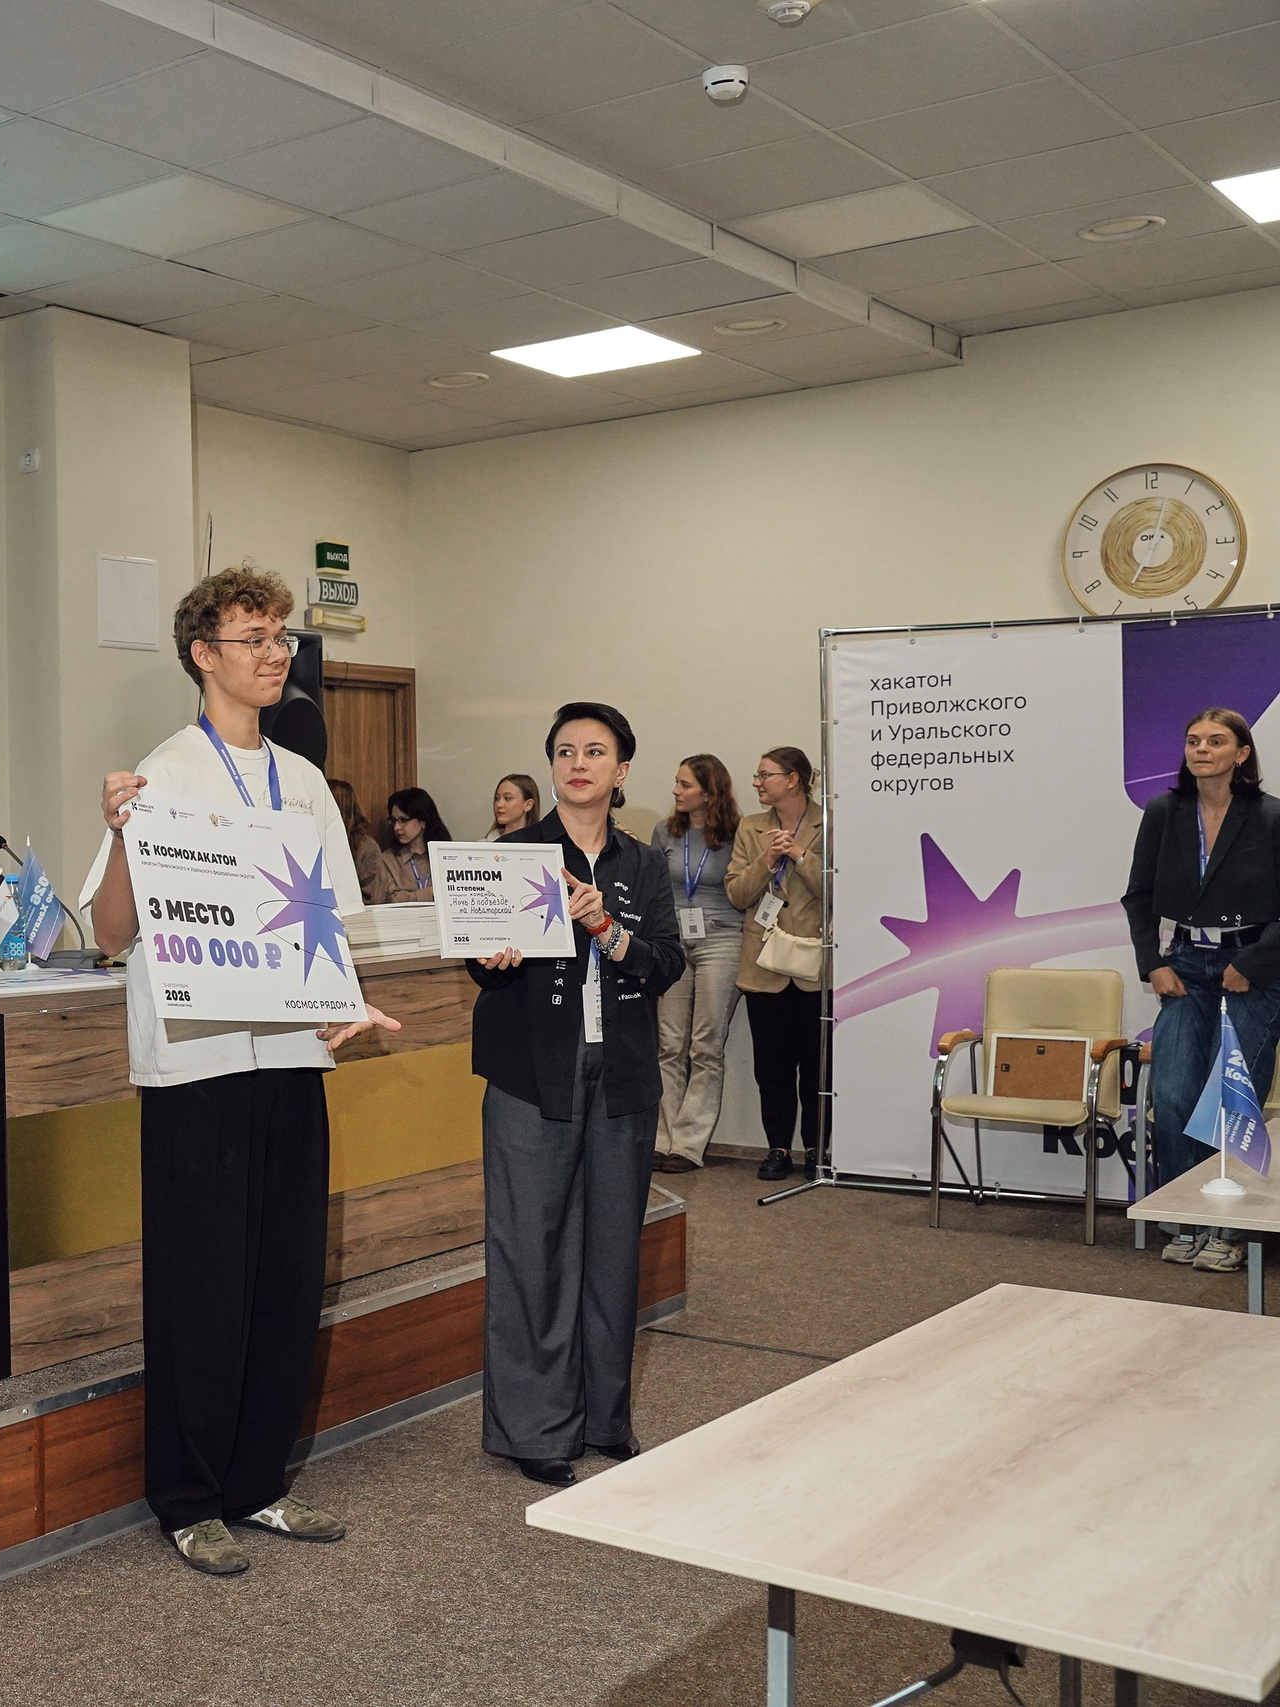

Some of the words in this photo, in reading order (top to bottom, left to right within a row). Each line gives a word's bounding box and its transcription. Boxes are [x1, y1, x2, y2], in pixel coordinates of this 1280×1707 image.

[1144, 471, 1158, 489] 12
[1206, 501, 1224, 515] 2
[1078, 514, 1099, 531] 10
[326, 552, 348, 562] ВЫХОД
[322, 582, 357, 604] ВЫХОД
[870, 674, 952, 691] хакатон
[871, 696, 1027, 719] Приволжского
[871, 729, 882, 741] и
[888, 723, 1011, 744] Уральского
[871, 750, 1015, 770] федеральных
[871, 778, 954, 795] округов
[153, 845, 237, 866] КОСМОХАКАТОН
[446, 869, 502, 882] ДИПЛОМ
[149, 897, 163, 920] 3
[165, 899, 235, 926] МЕСТО
[153, 933, 203, 965] 100
[208, 938, 259, 969] 000
[165, 989, 191, 1001] 2026
[284, 1000, 319, 1009] КОСМОС
[320, 1001, 348, 1010] РЯДОМ
